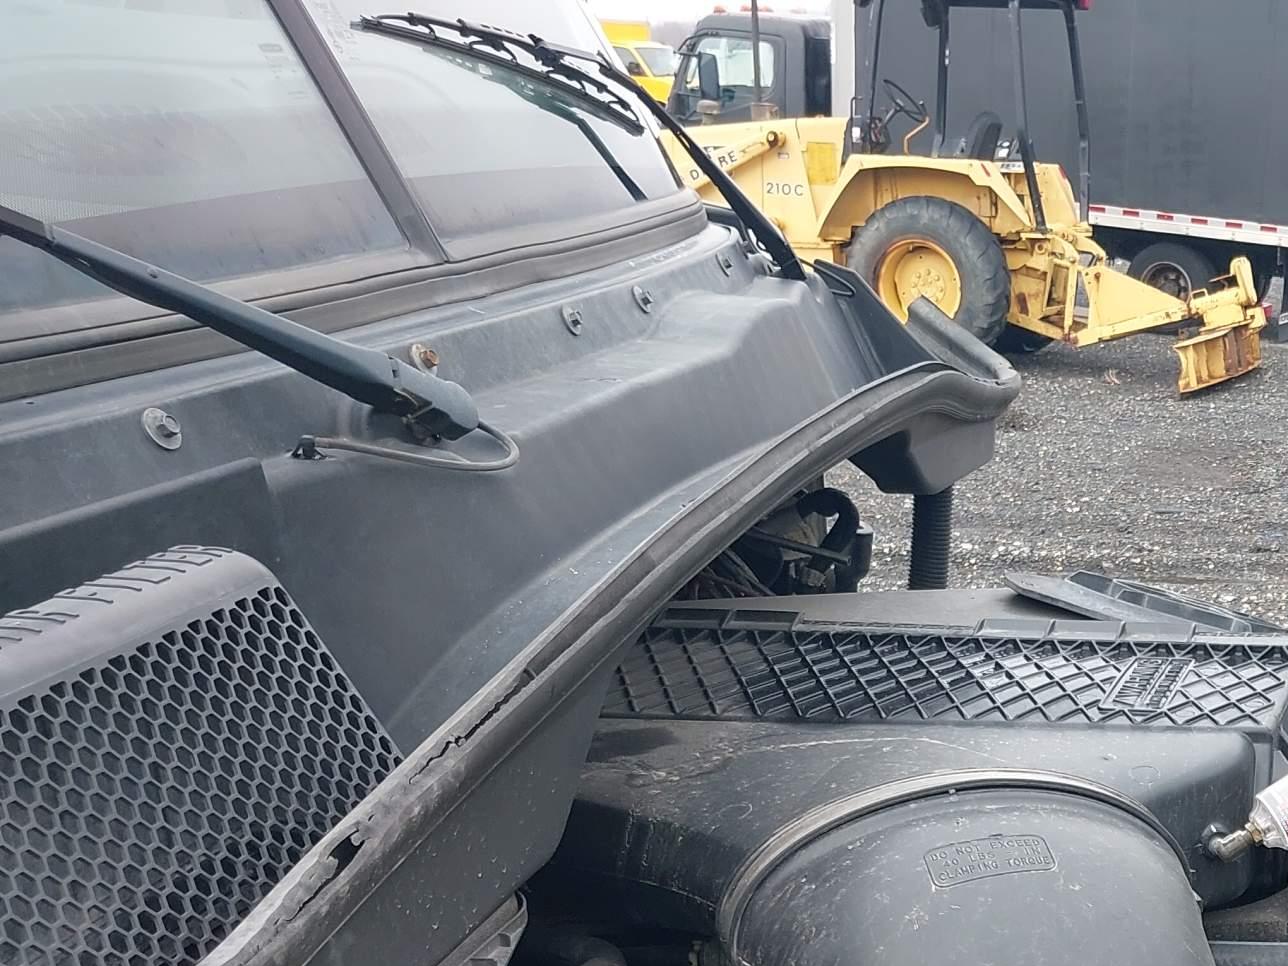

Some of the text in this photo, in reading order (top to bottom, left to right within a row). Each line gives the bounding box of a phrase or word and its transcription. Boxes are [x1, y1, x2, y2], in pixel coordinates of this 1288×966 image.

[52, 544, 234, 605] FILTER
[955, 845, 981, 857] NOT
[989, 839, 1041, 850] EXCEED
[968, 852, 996, 863] LBS
[938, 855, 1051, 882] CLAMPING TORQUE
